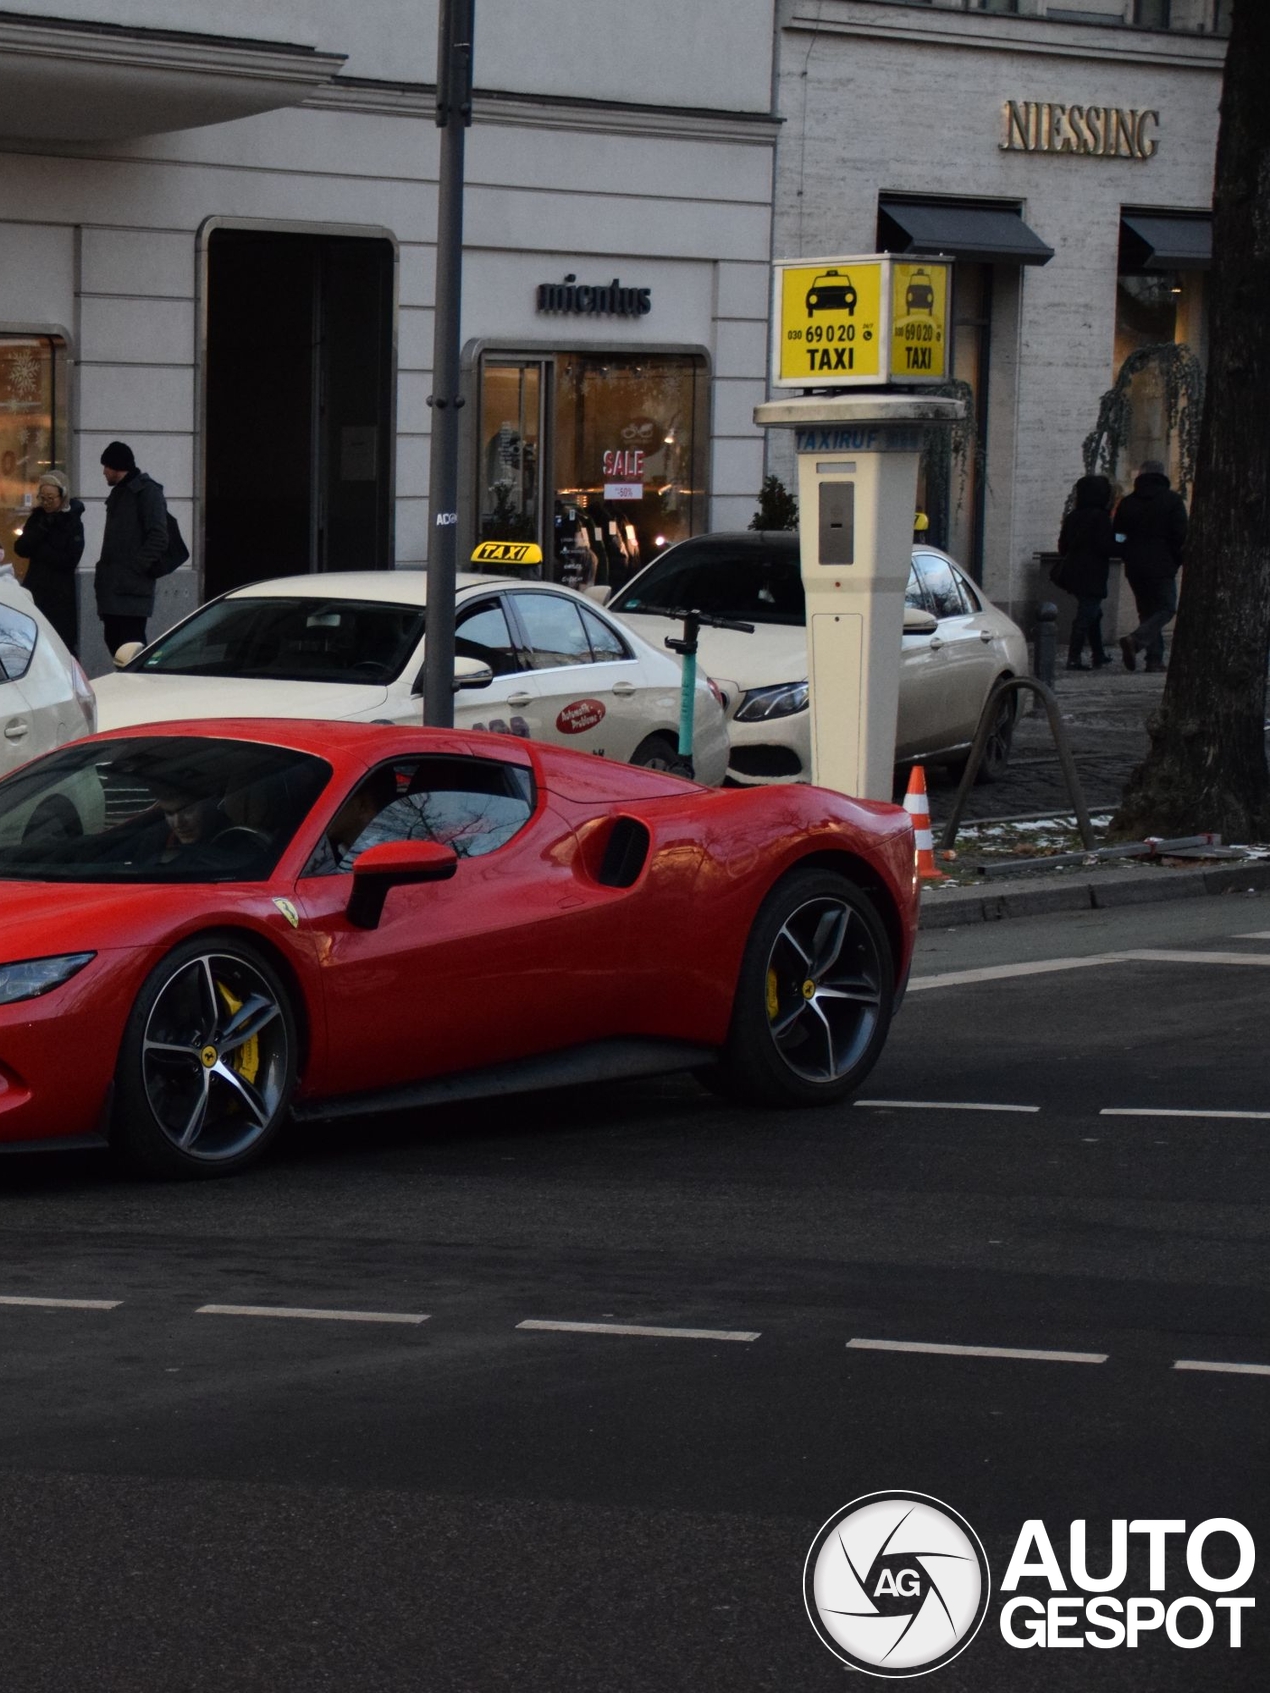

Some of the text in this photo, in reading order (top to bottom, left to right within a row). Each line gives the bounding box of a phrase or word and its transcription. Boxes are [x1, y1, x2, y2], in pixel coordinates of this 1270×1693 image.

[998, 100, 1161, 160] NIESSING
[537, 273, 651, 315] mientus
[787, 330, 802, 340] 030
[806, 347, 854, 370] TAXI
[905, 346, 932, 369] TAXI
[795, 427, 877, 450] TAXIRUF
[603, 450, 645, 477] SALE
[483, 545, 527, 560] TAXI
